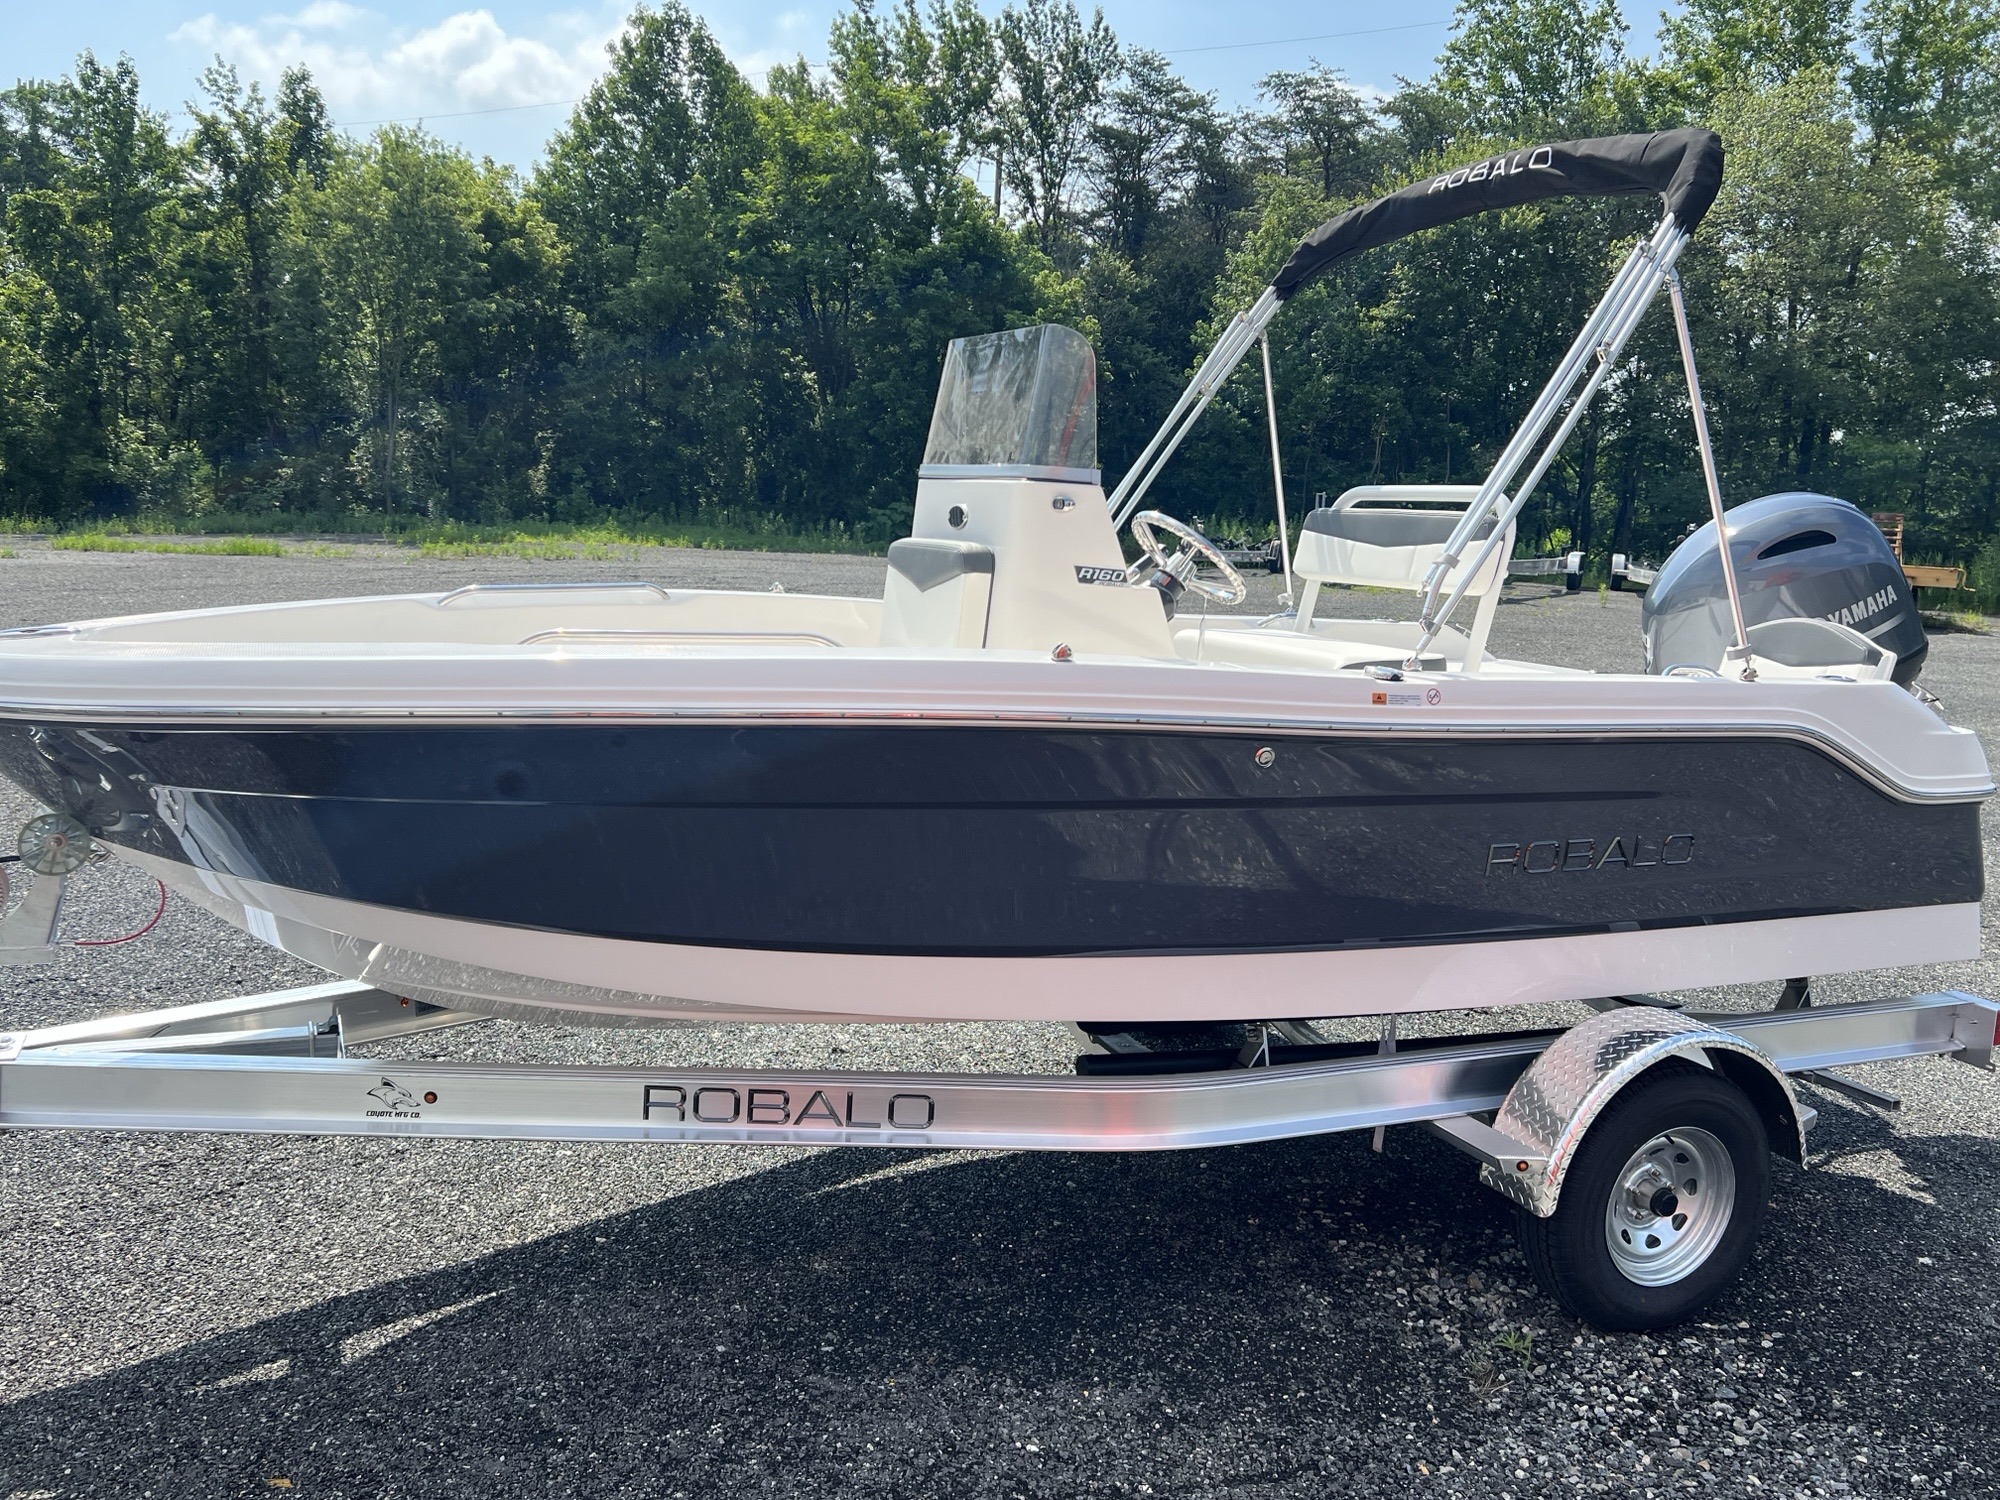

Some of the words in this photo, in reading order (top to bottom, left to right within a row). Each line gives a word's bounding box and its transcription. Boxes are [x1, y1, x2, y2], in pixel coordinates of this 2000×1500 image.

[1427, 146, 1553, 195] ROBALO
[1078, 567, 1125, 582] R160
[1827, 584, 1898, 627] YAMAHA
[1484, 833, 1695, 876] ROBALO
[366, 1110, 394, 1118] COYOTE
[642, 1084, 935, 1129] ROBALO
